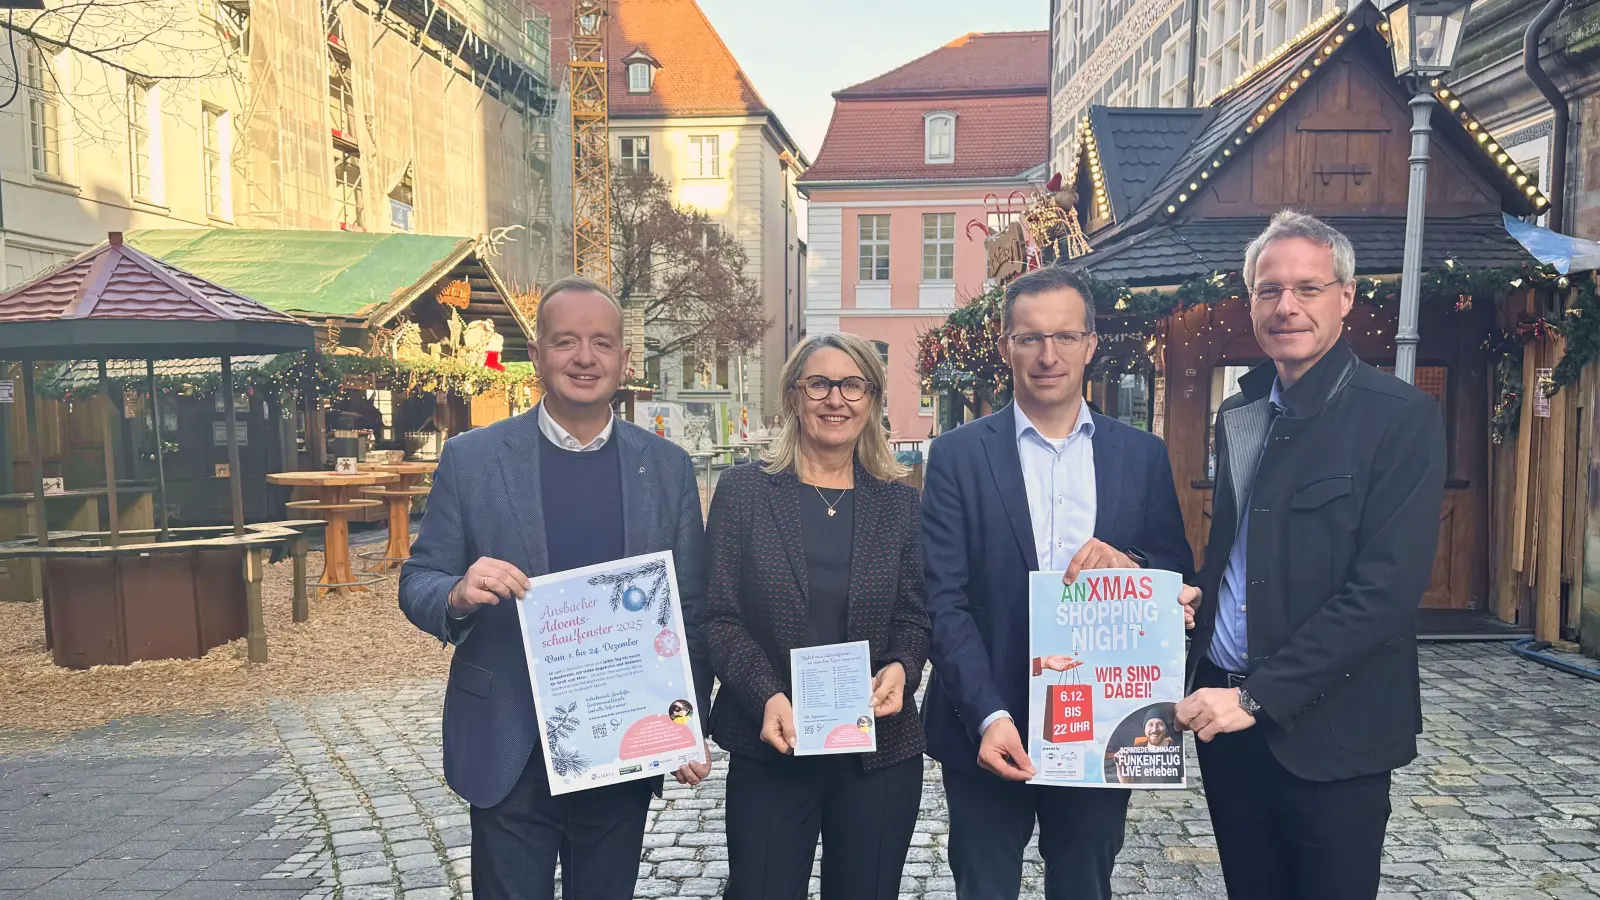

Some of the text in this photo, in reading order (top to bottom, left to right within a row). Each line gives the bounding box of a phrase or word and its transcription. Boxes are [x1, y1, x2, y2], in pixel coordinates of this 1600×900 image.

[1061, 575, 1153, 602] ANXMAS
[540, 597, 598, 619] Ansbacher
[1056, 600, 1158, 626] SHOPPING
[616, 620, 643, 632] 2025
[1071, 624, 1142, 651] NIGHT
[544, 655, 566, 663] Vom
[575, 649, 587, 657] bis
[602, 638, 639, 652] Dezember
[1095, 665, 1161, 682] WIR SIND
[1060, 691, 1085, 701] 6.12.
[1104, 682, 1152, 698] DABEI!
[1064, 706, 1082, 717] BIS
[1053, 721, 1090, 735] 22 UHR
[1119, 754, 1180, 766] FUNKENFLUG
[1121, 765, 1178, 777] LIVE erleben
